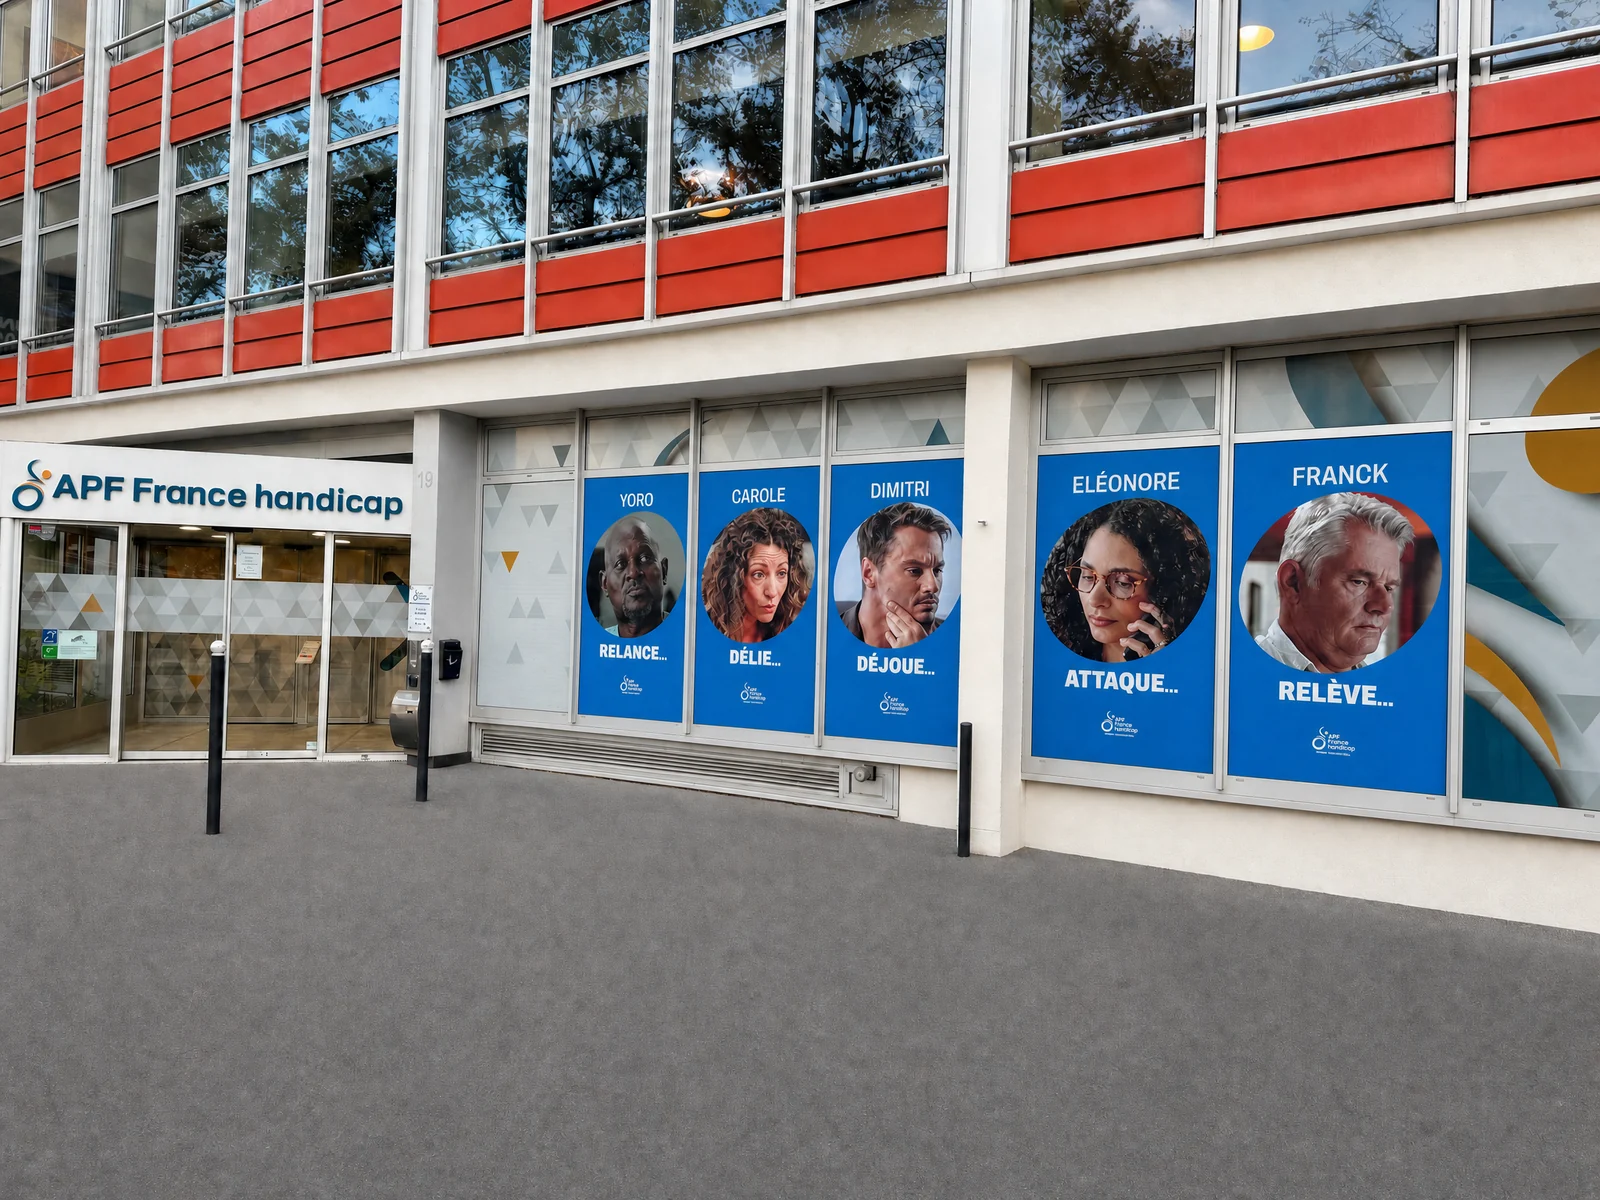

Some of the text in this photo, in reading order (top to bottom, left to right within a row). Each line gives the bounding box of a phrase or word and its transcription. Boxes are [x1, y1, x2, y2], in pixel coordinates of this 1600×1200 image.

[417, 470, 434, 489] 19
[1073, 470, 1180, 494] ELÉONORE
[1293, 463, 1389, 486] FRANCK
[52, 473, 404, 521] APF France handicap
[619, 492, 654, 507] YORO
[732, 487, 786, 504] CAROLE
[870, 480, 930, 499] DIMITRI
[599, 643, 668, 661] RELANCE...
[729, 647, 781, 667] DÉLIE...
[857, 652, 935, 676] DÉJOUE...
[1064, 669, 1179, 694] ATTAQUE...
[1278, 678, 1394, 707] RELÈVE...
